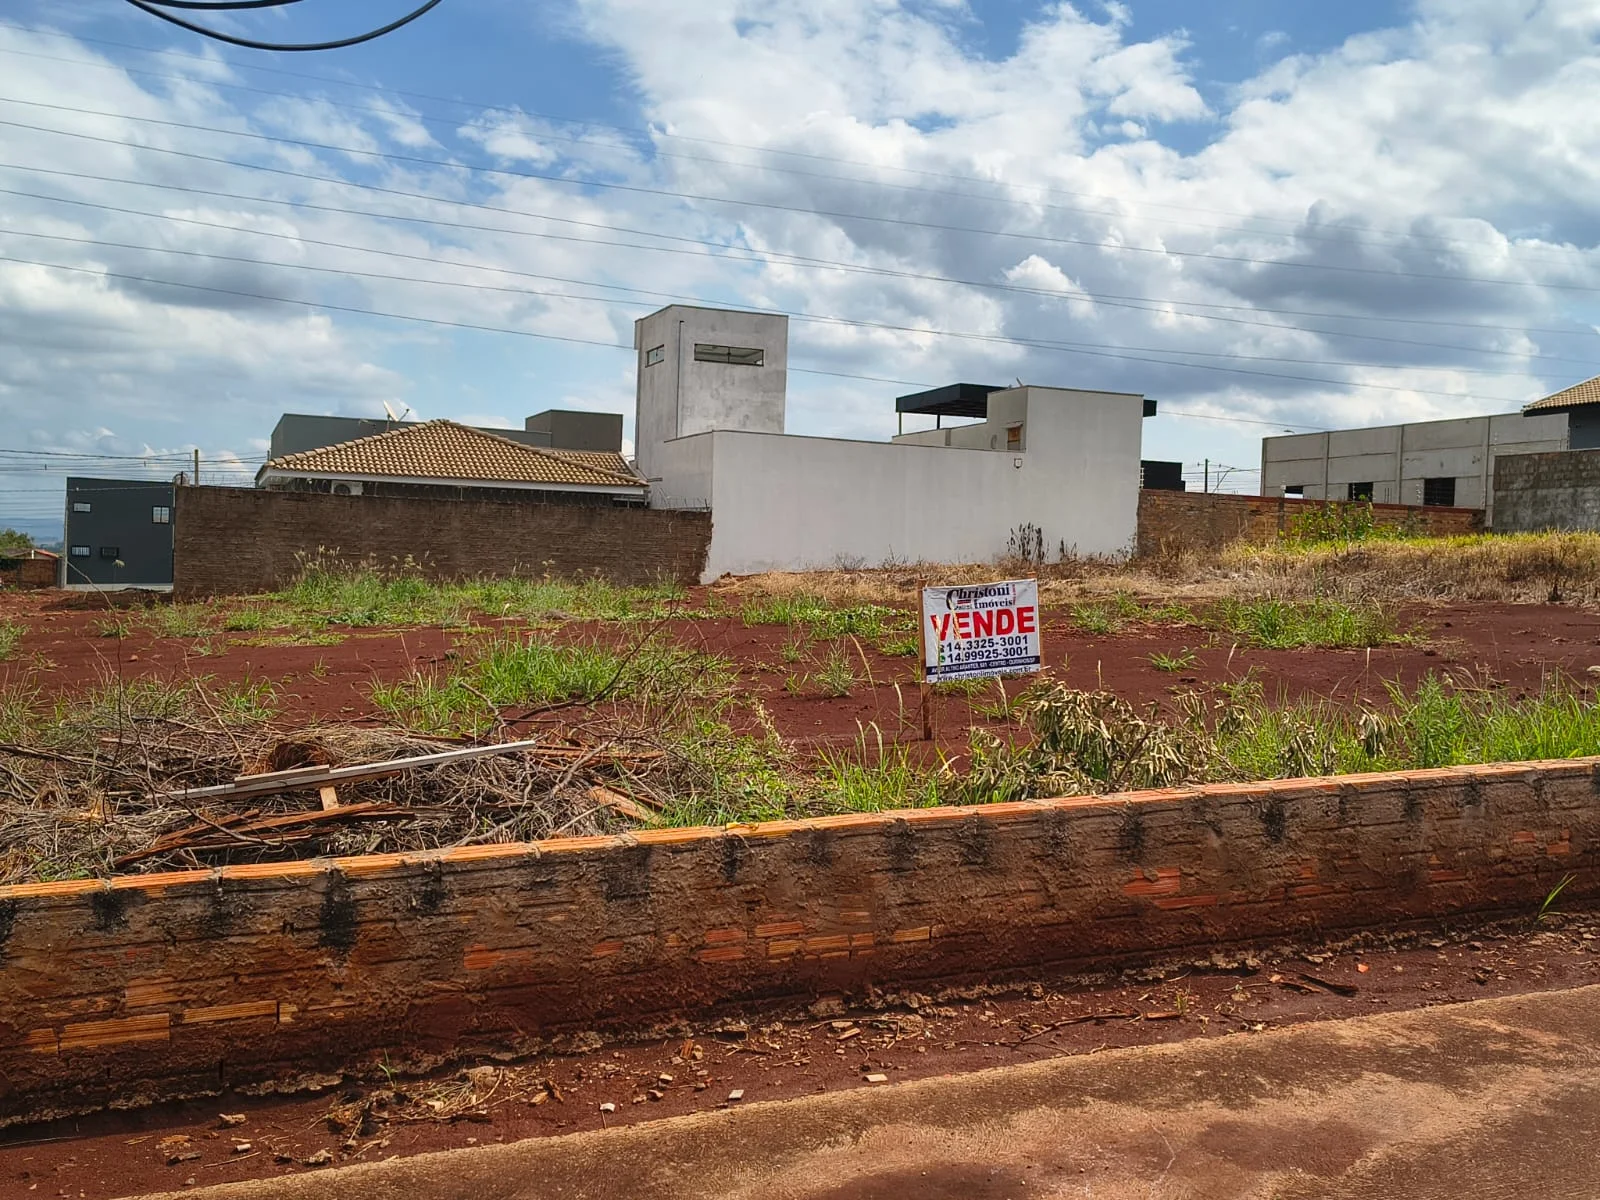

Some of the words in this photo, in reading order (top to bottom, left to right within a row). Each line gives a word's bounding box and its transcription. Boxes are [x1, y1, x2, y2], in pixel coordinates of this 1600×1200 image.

[946, 584, 1010, 611] Christoni
[974, 598, 1013, 609] Imóveis
[930, 606, 1036, 641] VENDE
[946, 635, 1029, 652] 14.3325-3001
[947, 646, 1029, 663] 14.99925-3001
